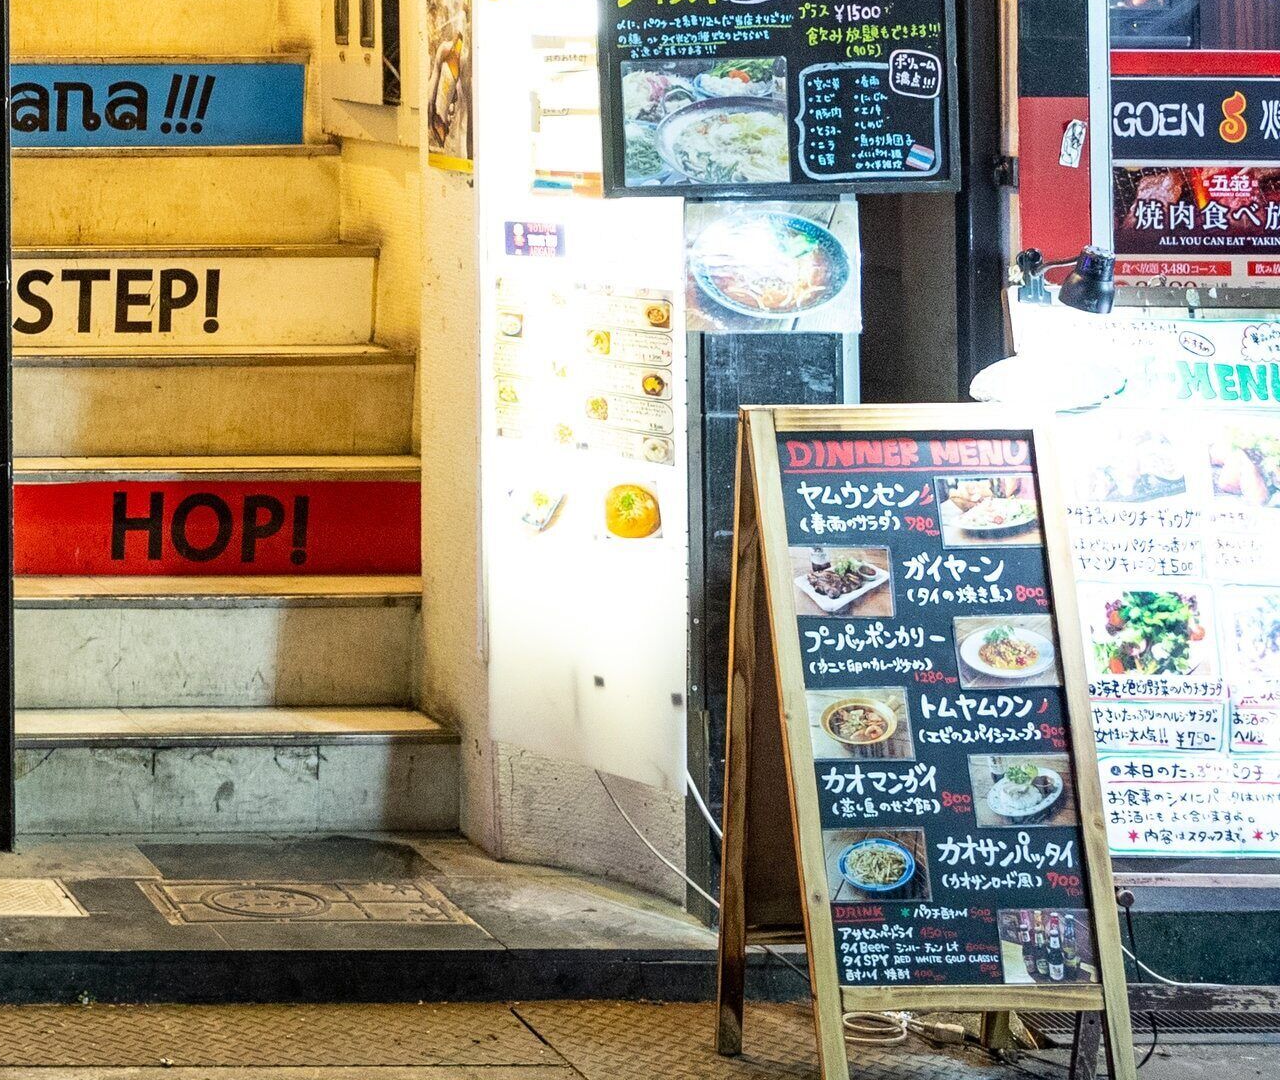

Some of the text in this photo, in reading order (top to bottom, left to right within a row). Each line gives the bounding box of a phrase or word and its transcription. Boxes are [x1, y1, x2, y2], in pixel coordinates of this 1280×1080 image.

[834, 4, 881, 23] ¥1500
[1113, 101, 1205, 138] GOEN
[1159, 237, 1246, 246] ALL YOU CAN EAT
[12, 267, 221, 335] STEP!
[785, 437, 1028, 468] DINNER MENU
[796, 480, 920, 510] ヤムウンセン
[111, 491, 310, 566] HOP!
[904, 516, 934, 532] 780
[902, 551, 1005, 583] ガイヤーン
[1015, 585, 1045, 602] 800
[804, 620, 946, 654] プーパッポンカリー
[920, 693, 1034, 722] トムヤムクン
[821, 763, 938, 795] カオマンガイ
[941, 791, 971, 808] 800
[937, 831, 1074, 869] カオサンパッタイ
[833, 906, 885, 919] DRINK
[893, 954, 911, 965] RED
[915, 954, 943, 964] WHITE
[945, 954, 966, 964] GOLD
